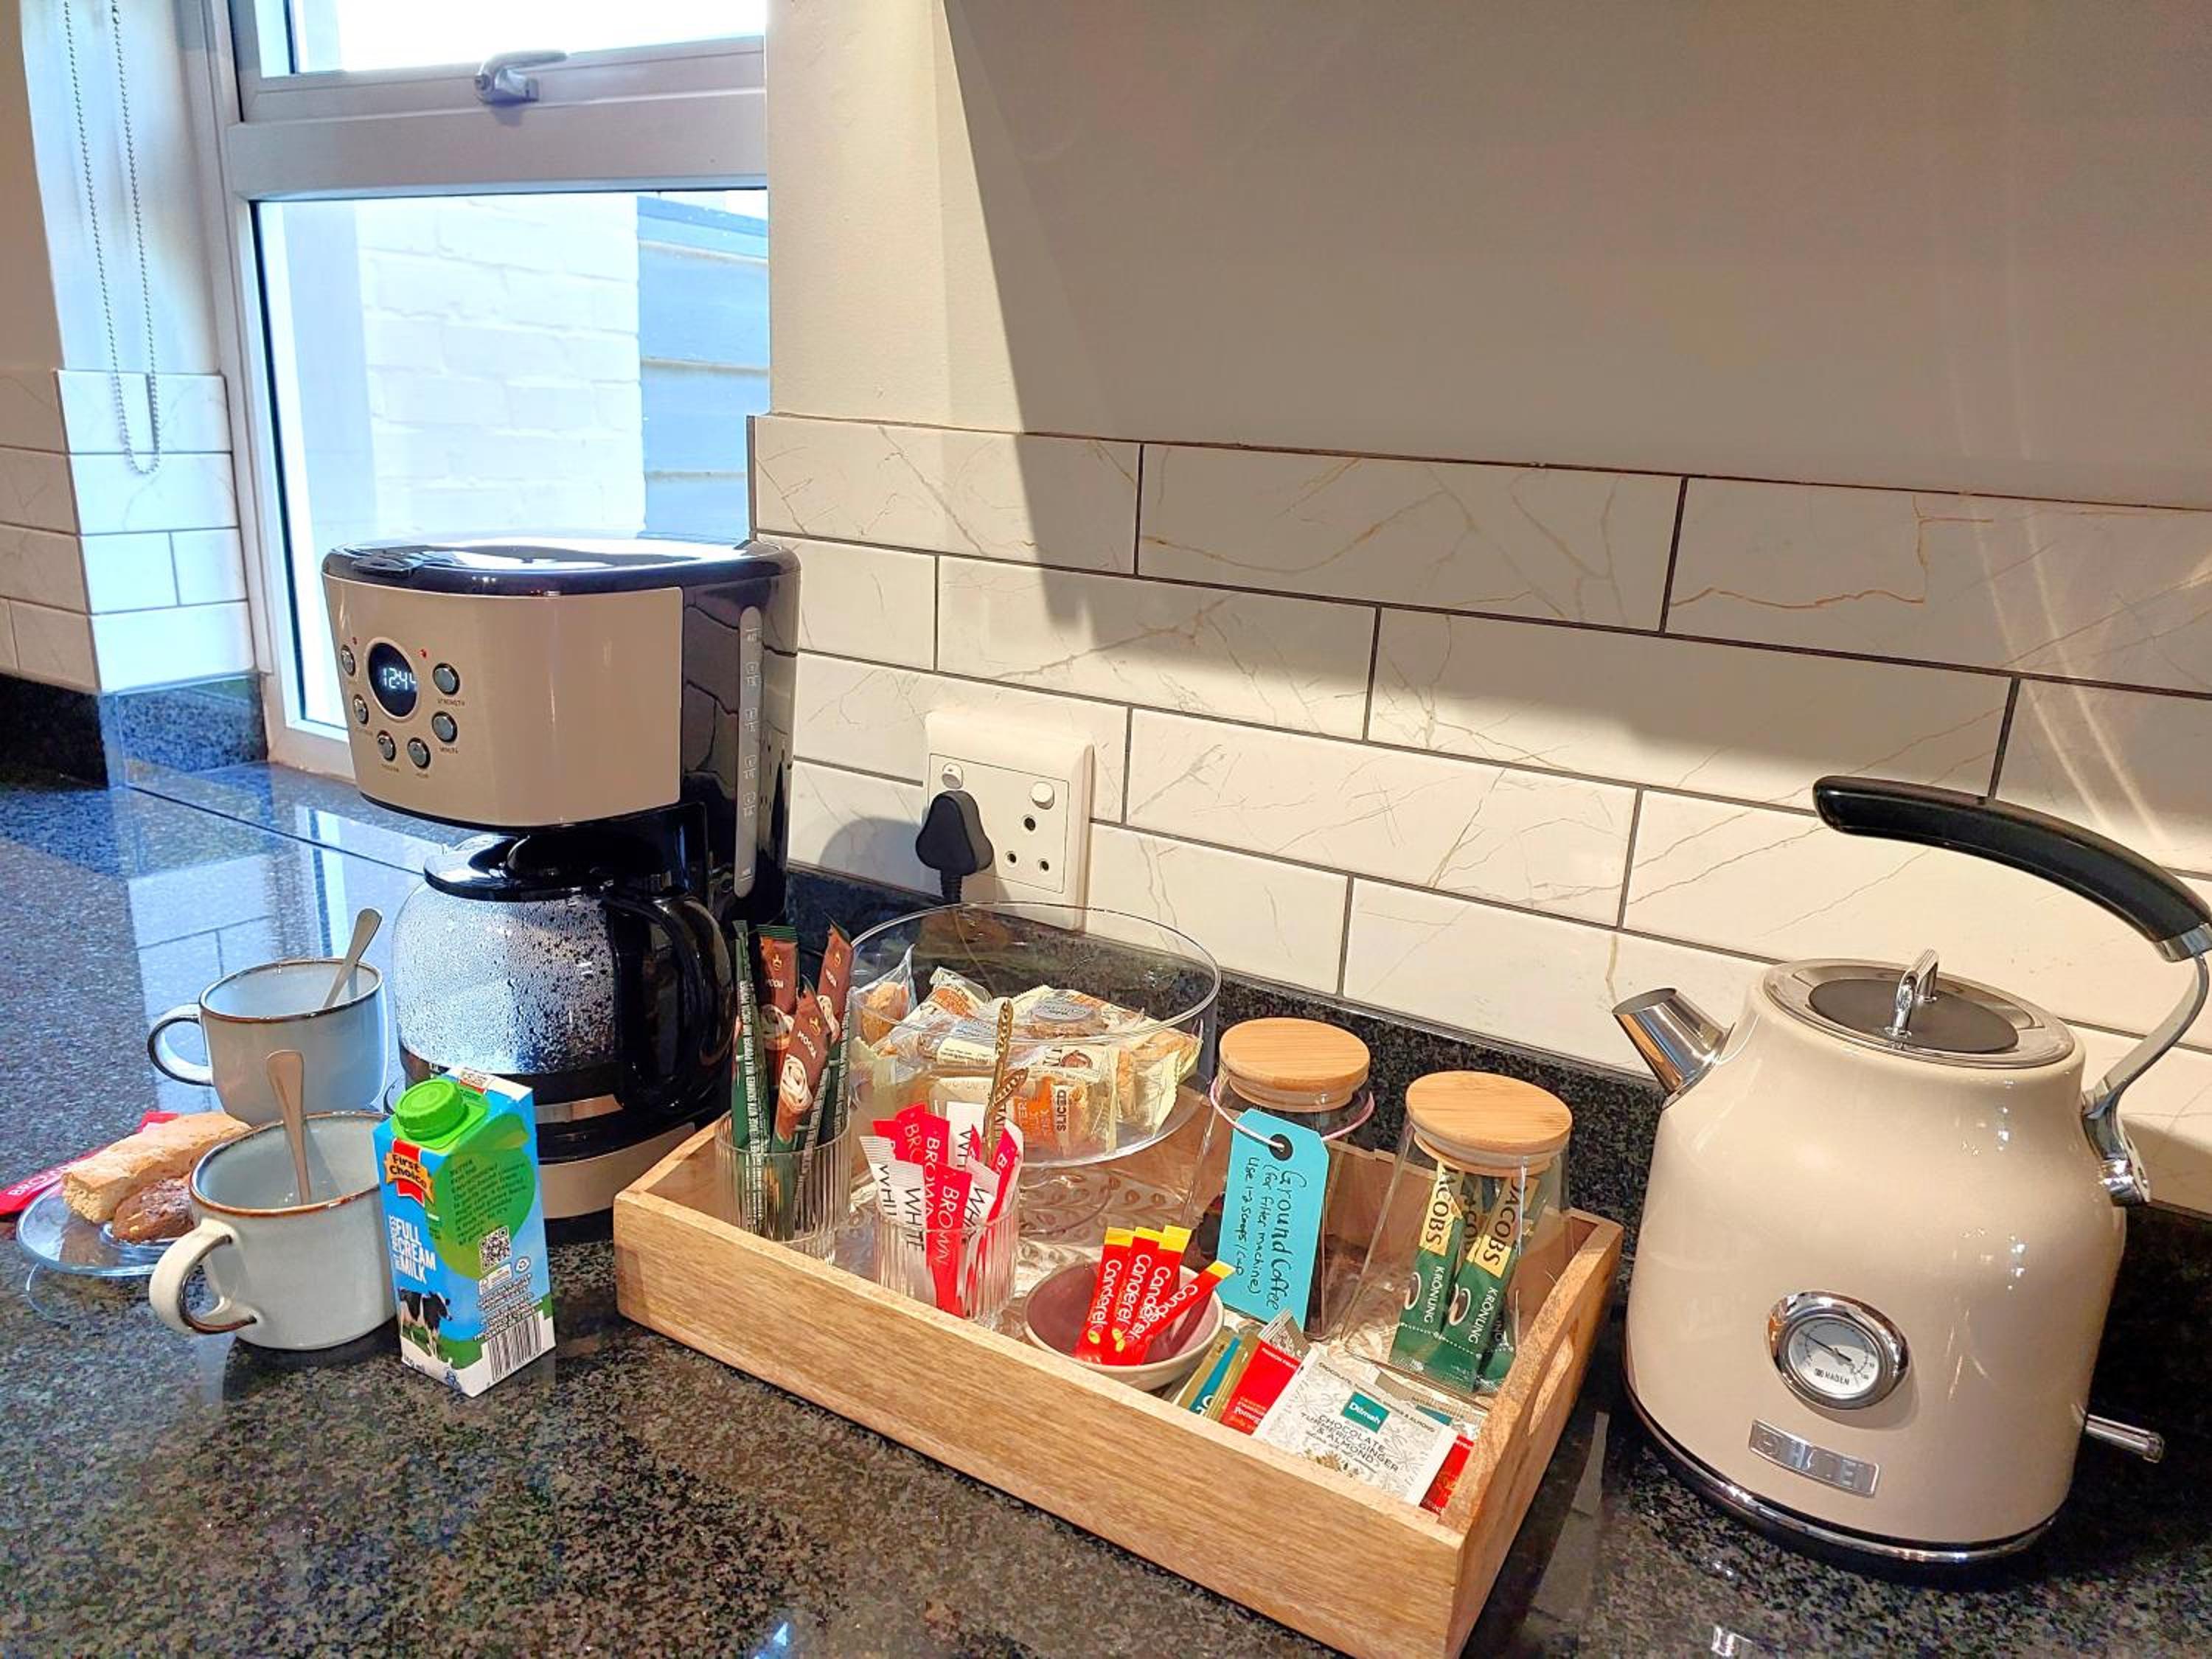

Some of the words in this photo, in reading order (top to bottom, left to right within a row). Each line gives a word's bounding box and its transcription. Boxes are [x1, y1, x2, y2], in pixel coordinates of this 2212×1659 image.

[1057, 1090, 1067, 1132] SLICED
[392, 1153, 420, 1173] First
[905, 1123, 922, 1164] BRO
[389, 1164, 427, 1189] Choice
[904, 1188, 925, 1251] WHTE
[933, 1186, 959, 1266] BROWN
[1270, 1169, 1307, 1256] Ground
[1426, 1170, 1456, 1246] ACOBS
[1483, 1178, 1521, 1266] JACOBS
[398, 1237, 437, 1271] CREAM
[1090, 1259, 1123, 1329] Canderel
[1116, 1254, 1152, 1326] Canderel
[1266, 1258, 1292, 1310] Coffee
[1468, 1287, 1499, 1344] KRÖNUNG
[1349, 1401, 1381, 1425] Dilmah
[1329, 1433, 1374, 1464] ALMOND
